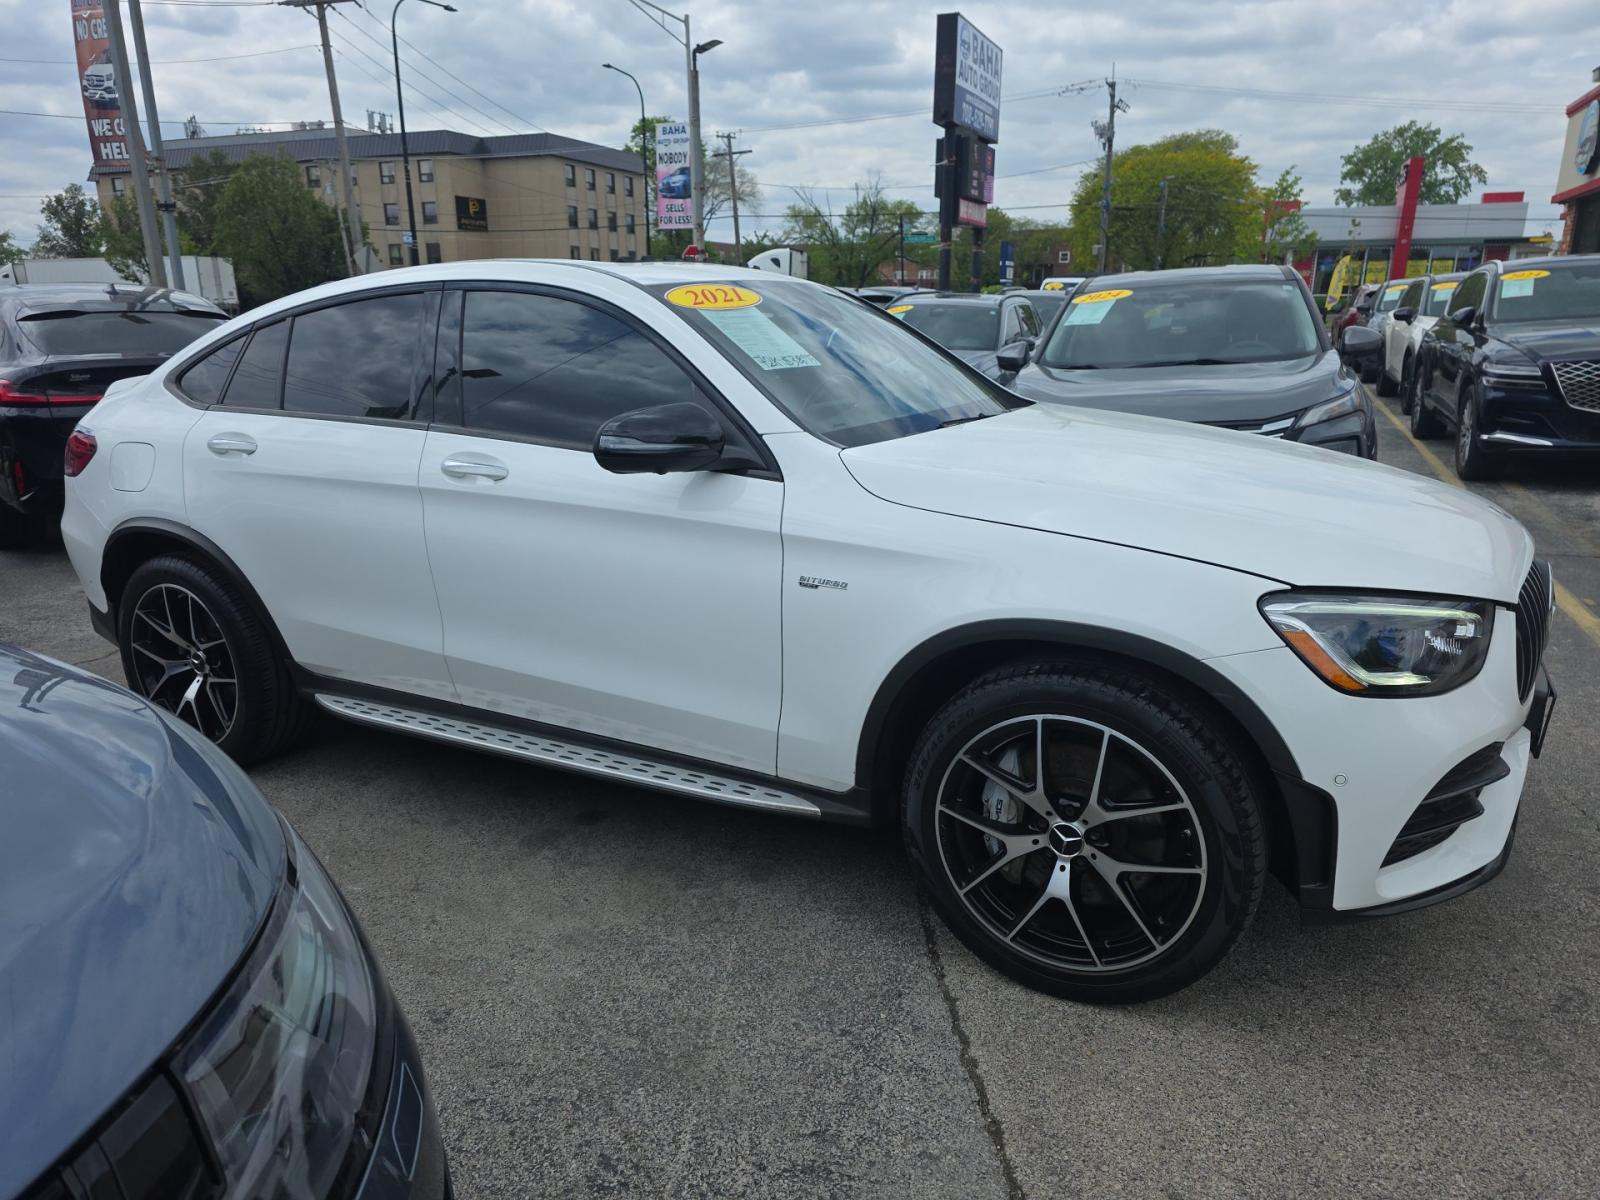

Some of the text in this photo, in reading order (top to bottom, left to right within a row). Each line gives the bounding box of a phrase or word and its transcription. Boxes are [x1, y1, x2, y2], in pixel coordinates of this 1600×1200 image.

[75, 20, 88, 40] NO
[972, 31, 1000, 82] BAHA
[958, 59, 999, 103] AUTO GROUP
[91, 119, 113, 137] WE
[662, 125, 687, 135] BAHA
[658, 151, 687, 165] NOBODY
[665, 203, 685, 213] SELLS
[659, 215, 673, 225] FOR
[684, 287, 745, 306] 2021
[799, 575, 849, 589] BITURBO
